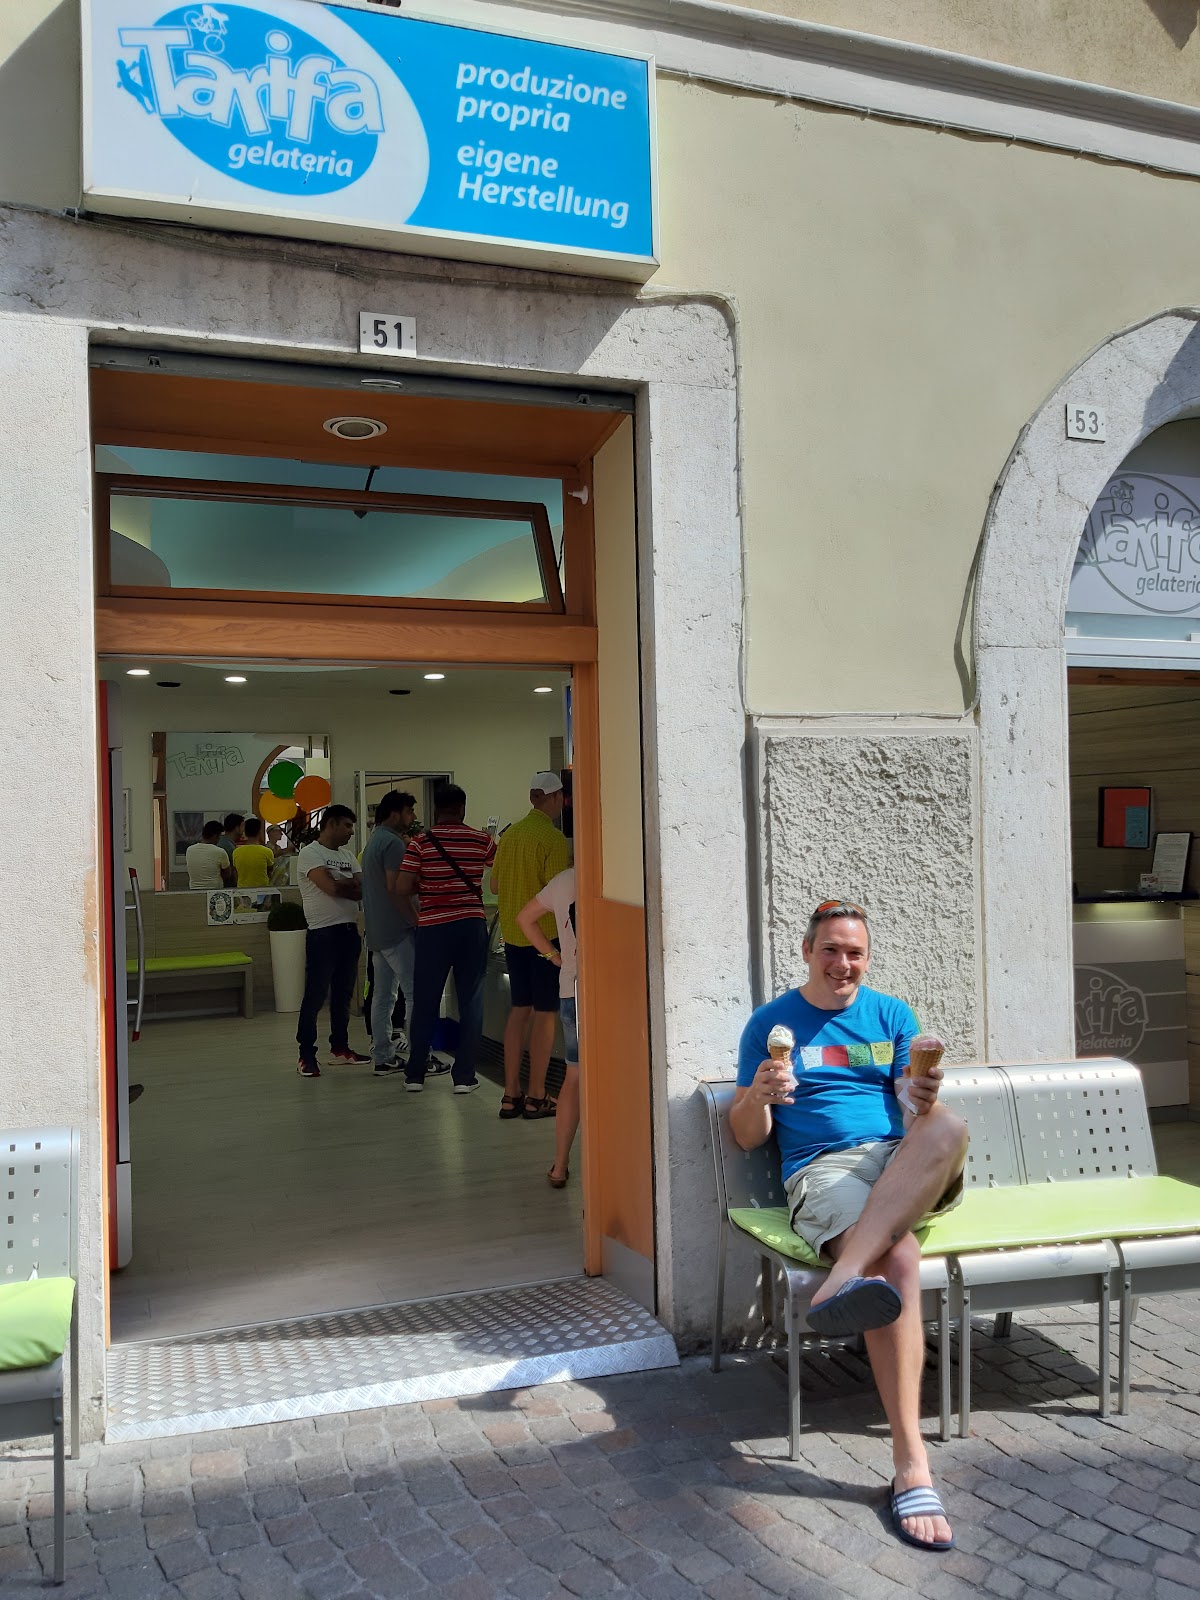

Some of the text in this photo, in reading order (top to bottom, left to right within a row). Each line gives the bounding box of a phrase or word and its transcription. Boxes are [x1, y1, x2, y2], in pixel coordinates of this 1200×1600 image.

[118, 27, 385, 144] Tarifa
[456, 62, 628, 111] produzione
[456, 94, 570, 133] propria
[228, 141, 353, 179] gelateria
[457, 142, 559, 180] eigene
[457, 172, 629, 229] Herstellung
[372, 319, 404, 350] 51
[1075, 409, 1099, 435] 53
[1075, 977, 1149, 1034] rifa
